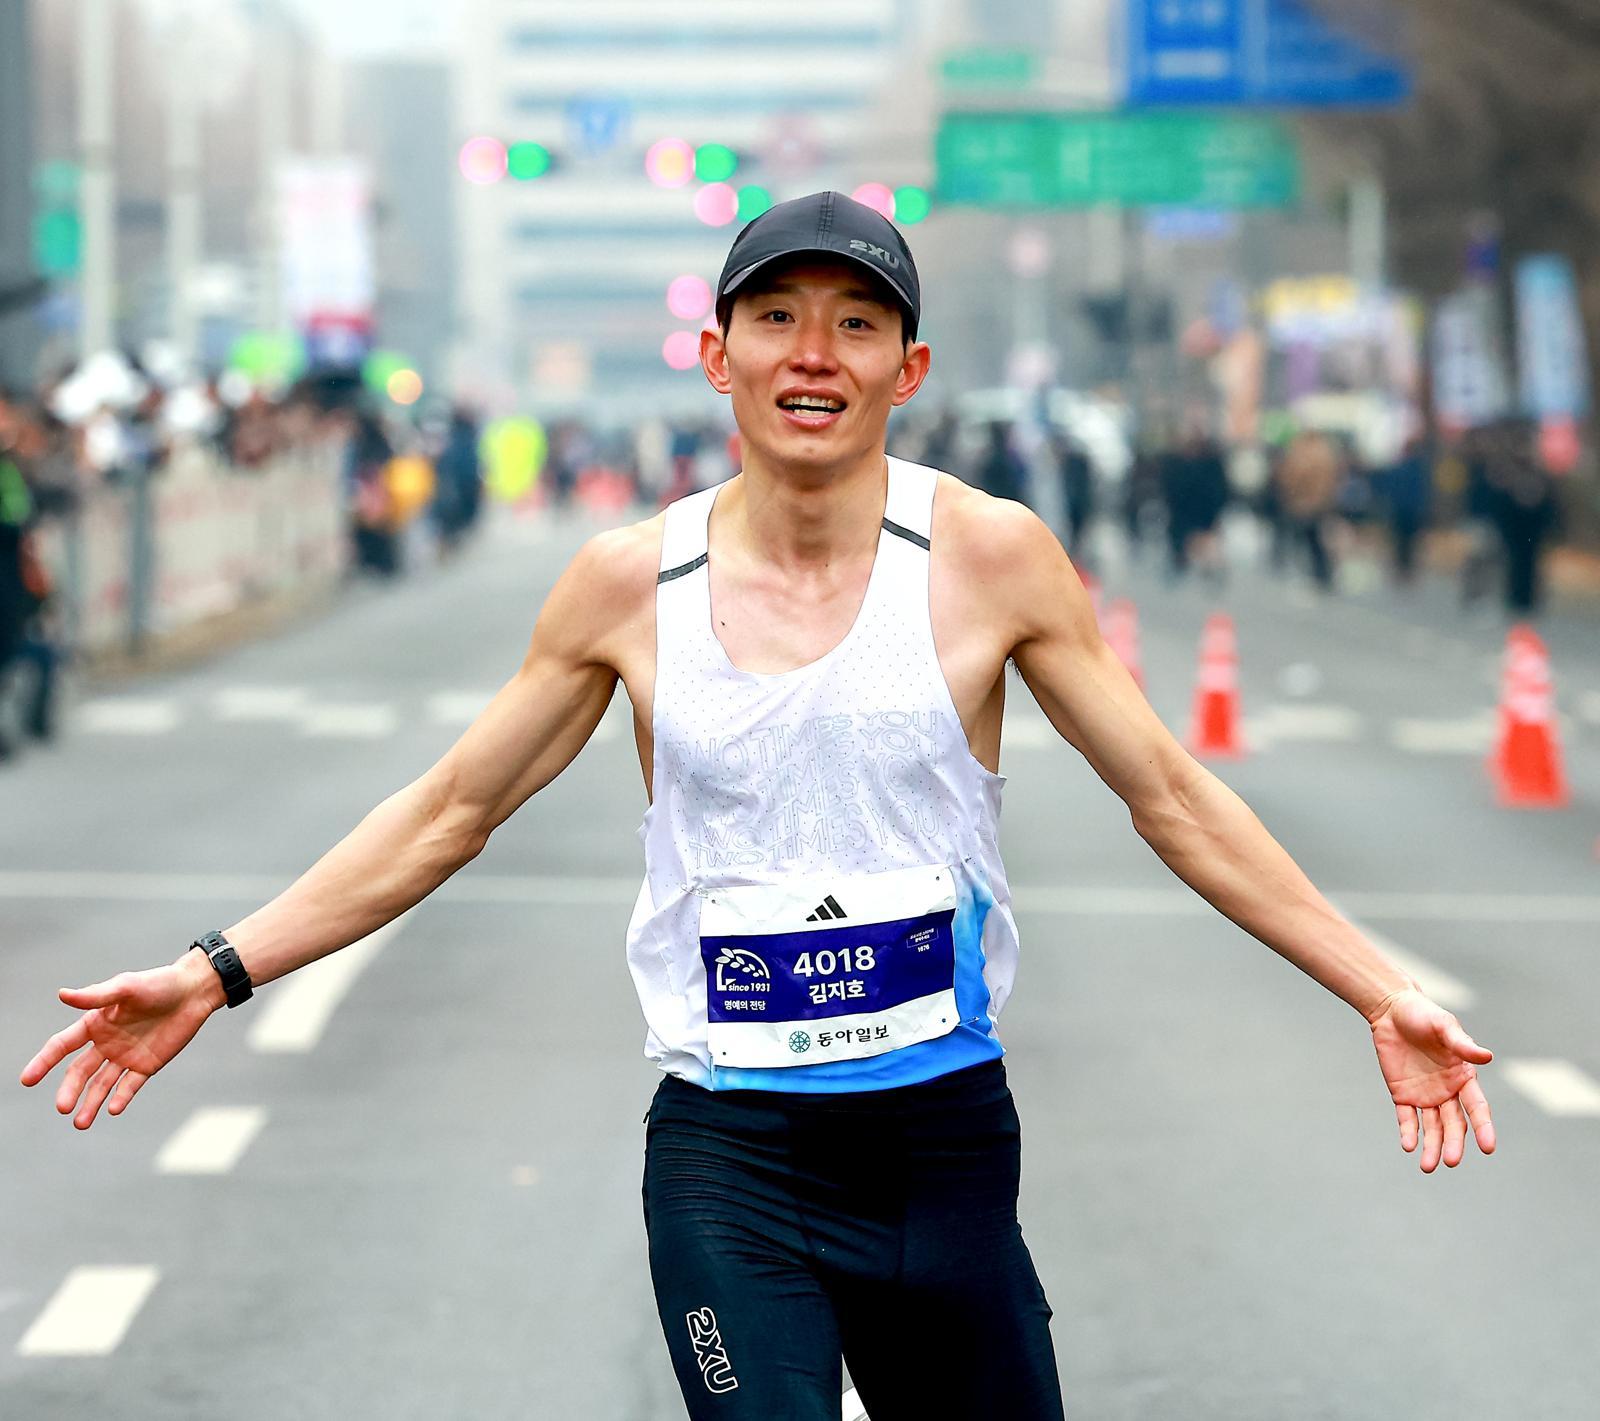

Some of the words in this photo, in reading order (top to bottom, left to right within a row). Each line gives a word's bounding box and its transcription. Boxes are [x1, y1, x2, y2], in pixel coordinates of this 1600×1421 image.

[849, 239, 900, 269] 2XU
[857, 711, 939, 739] YOU
[689, 839, 764, 869] TWO
[766, 803, 868, 862] TIMES
[864, 798, 941, 847] YOU
[793, 946, 875, 978] 4018
[728, 983, 750, 992] since
[750, 983, 771, 992] 1931
[809, 979, 866, 1004] 김지호
[724, 1000, 749, 1011] 명예의
[750, 1000, 766, 1011] 전당
[817, 1024, 890, 1048] 동아일보
[686, 1307, 739, 1394] 2XU
